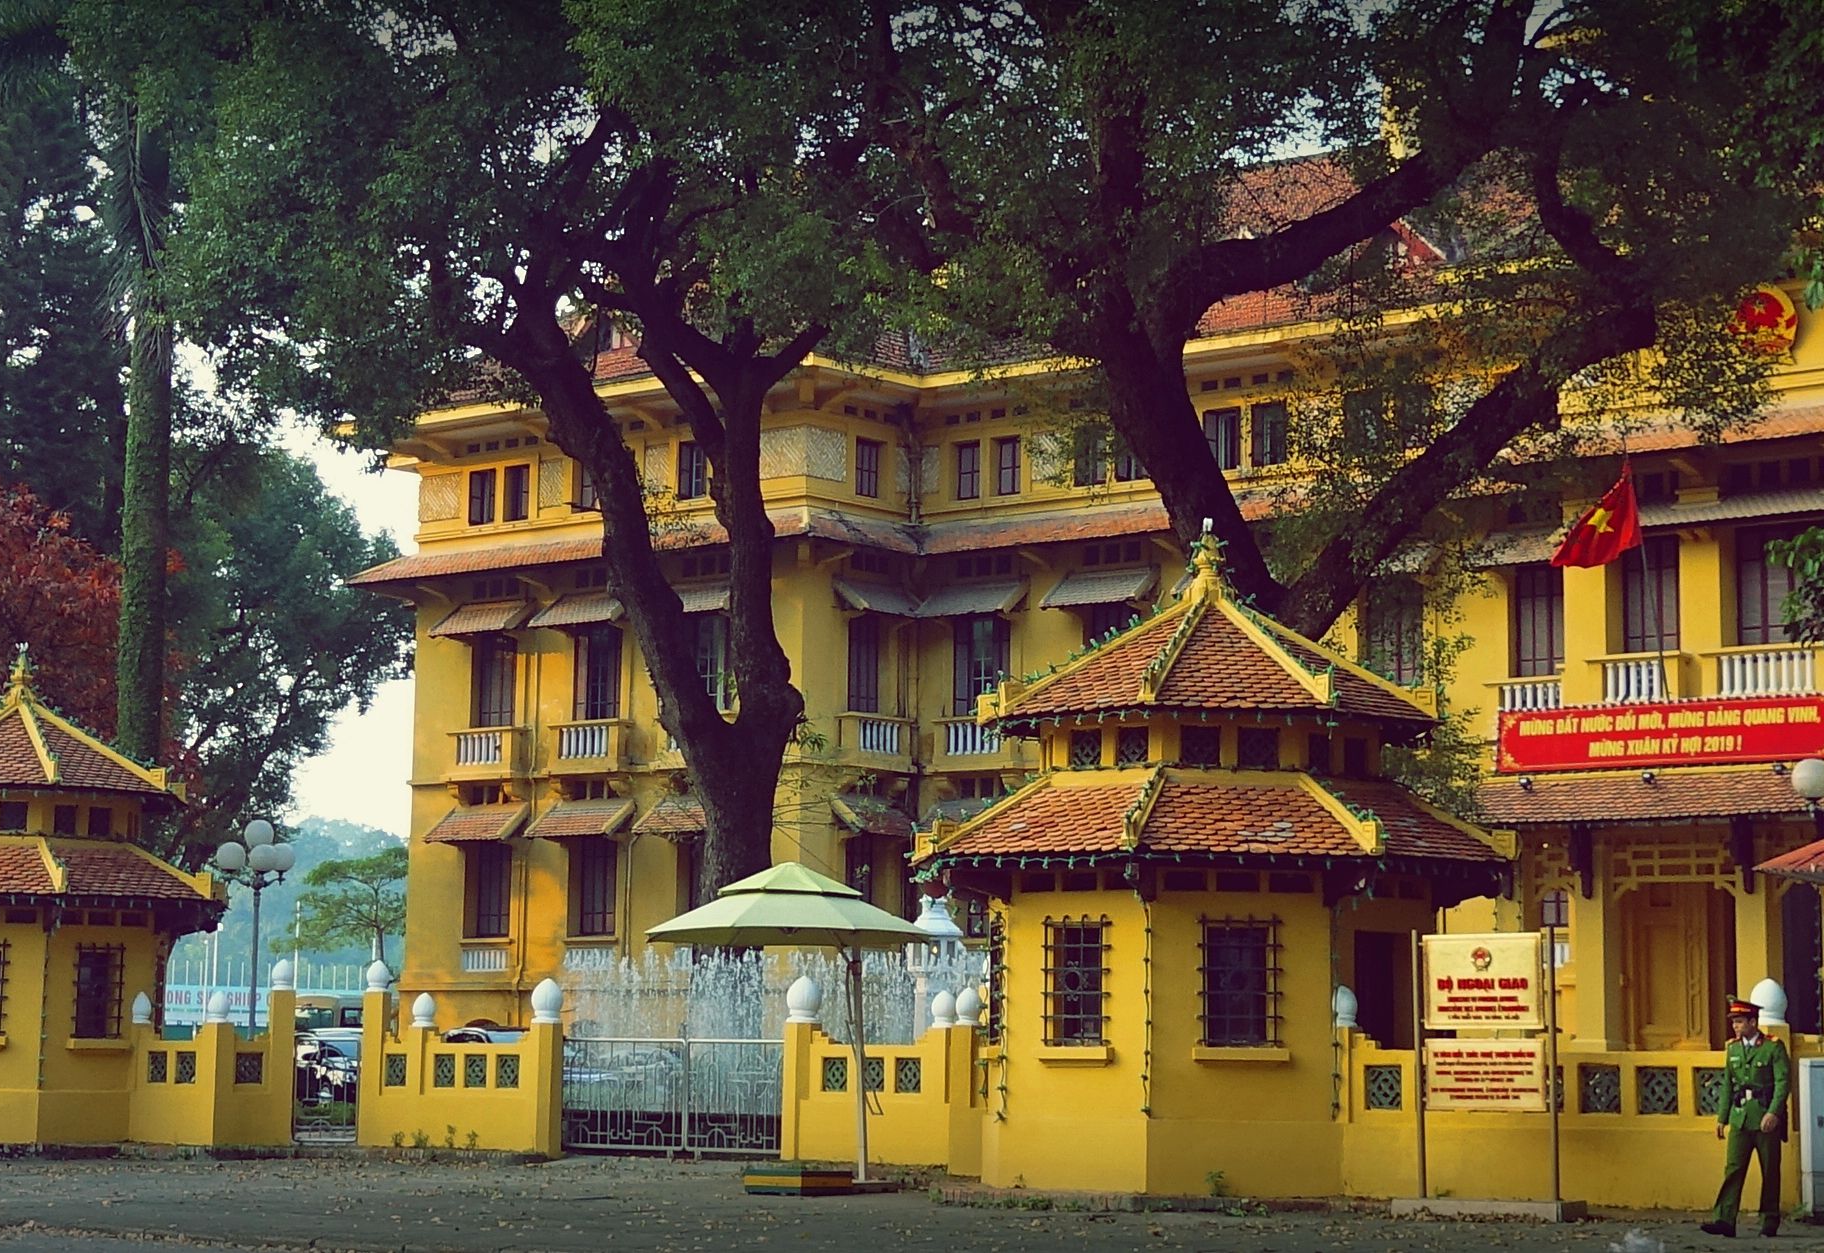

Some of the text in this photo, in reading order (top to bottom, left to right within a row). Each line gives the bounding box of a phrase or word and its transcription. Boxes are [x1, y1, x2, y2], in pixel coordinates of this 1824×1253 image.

[1519, 705, 1821, 737] MỪNG ĐẤT NƯỚC ĐỔI MỚI, MỪNG ĐẢNG QUANG VINH,
[1588, 738, 1625, 758] MỪNG
[1626, 736, 1660, 756] XUÂN
[1661, 733, 1679, 754] KỶ
[1680, 735, 1702, 757] HỢI
[1703, 735, 1735, 753] 2019
[166, 989, 192, 1006] ONG
